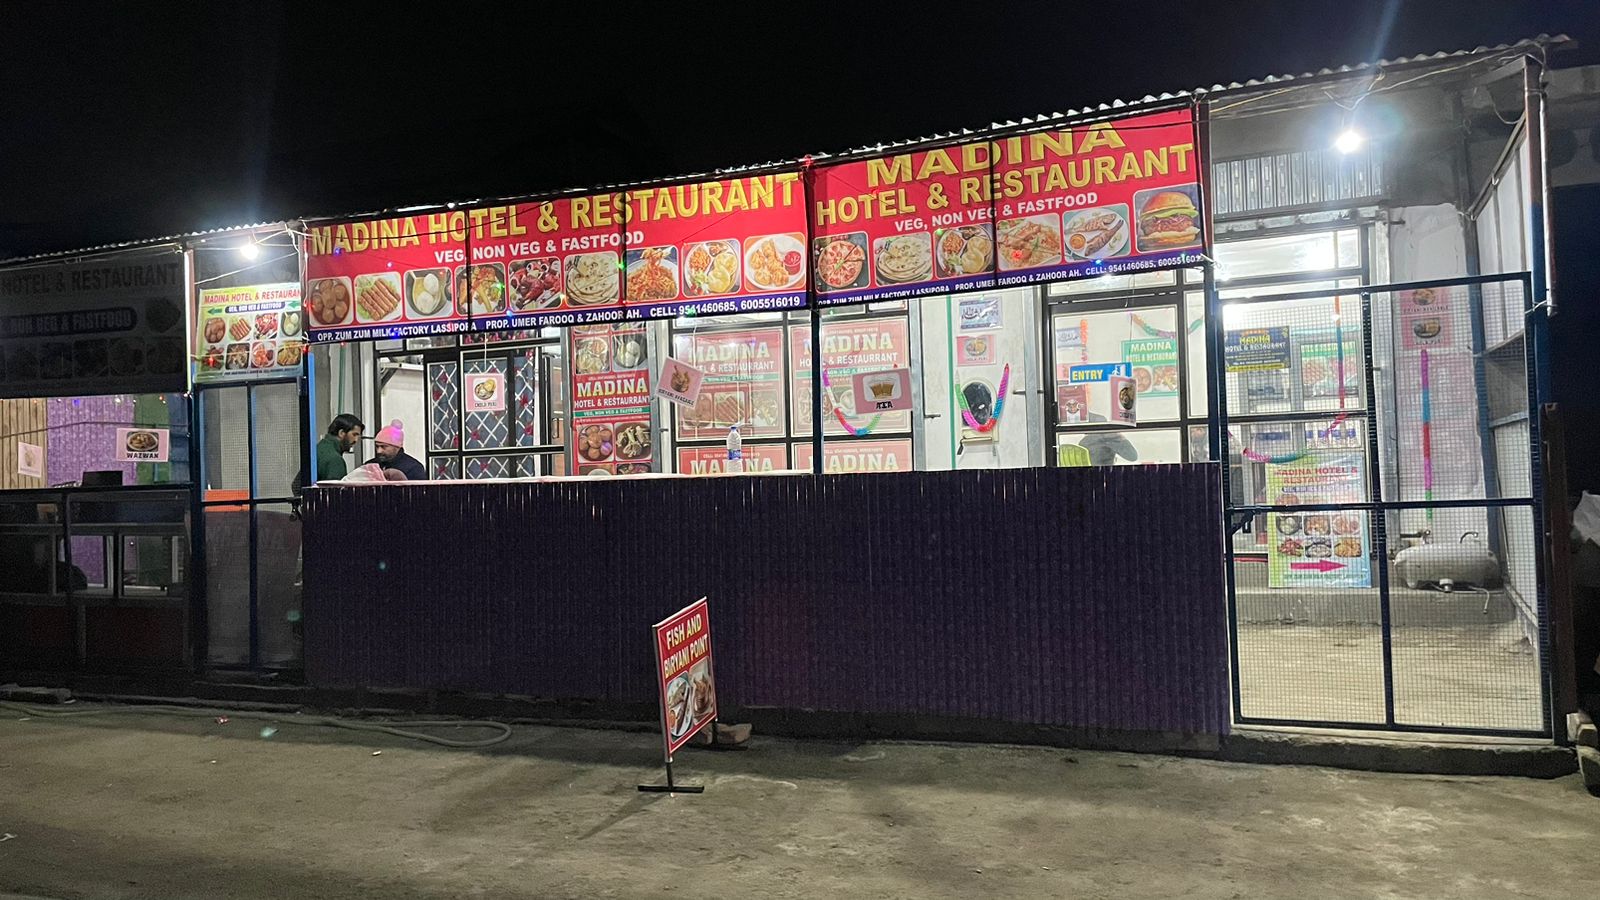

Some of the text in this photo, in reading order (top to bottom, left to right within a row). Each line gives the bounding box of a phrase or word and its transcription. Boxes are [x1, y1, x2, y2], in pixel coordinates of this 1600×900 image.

[866, 122, 1126, 187] MADINA
[816, 143, 1193, 226] HOTEL & RESTAURANT
[311, 172, 799, 256] MADINA HOTEL & RESTAURANT
[895, 192, 1098, 232] VEG, NON VEG & FASTFOOD
[473, 244, 506, 260] NON
[509, 241, 541, 256] VEG
[546, 239, 557, 252] &
[561, 231, 645, 251] FASTFOOD
[72, 263, 179, 291] RESTAURANT
[954, 281, 975, 291] PROP.
[998, 275, 1027, 286] FAROOQ
[1028, 274, 1035, 282] &
[1035, 270, 1068, 281] ZAHOOR
[1068, 268, 1082, 278] AH.
[1086, 267, 1107, 276] CELL:
[203, 295, 230, 304] MADINA
[232, 293, 253, 302] HOTEL
[255, 292, 260, 300] &
[317, 332, 334, 341] OPP.
[334, 330, 352, 340] ZUM
[353, 329, 370, 339] ZUM
[394, 325, 429, 337] FACTORY
[486, 319, 509, 330] PROP.
[511, 317, 537, 328] UMER
[539, 314, 575, 326] FAROOQ
[577, 313, 584, 322] &
[585, 311, 625, 322] ZAHOOR
[626, 308, 643, 318] AH.
[650, 307, 677, 317] CELL:
[740, 296, 801, 310] 6005516019
[1131, 341, 1172, 353] MADINA
[710, 363, 716, 372] &
[800, 358, 827, 368] HOL
[829, 356, 835, 365] &
[1072, 369, 1103, 381] ENTRY
[577, 377, 648, 398] MADINA
[574, 398, 596, 409] HOTEL
[597, 398, 602, 407] &
[690, 457, 773, 475] MANA
[666, 614, 702, 650] FISH AND
[664, 633, 708, 679] BIRYANI POINT
